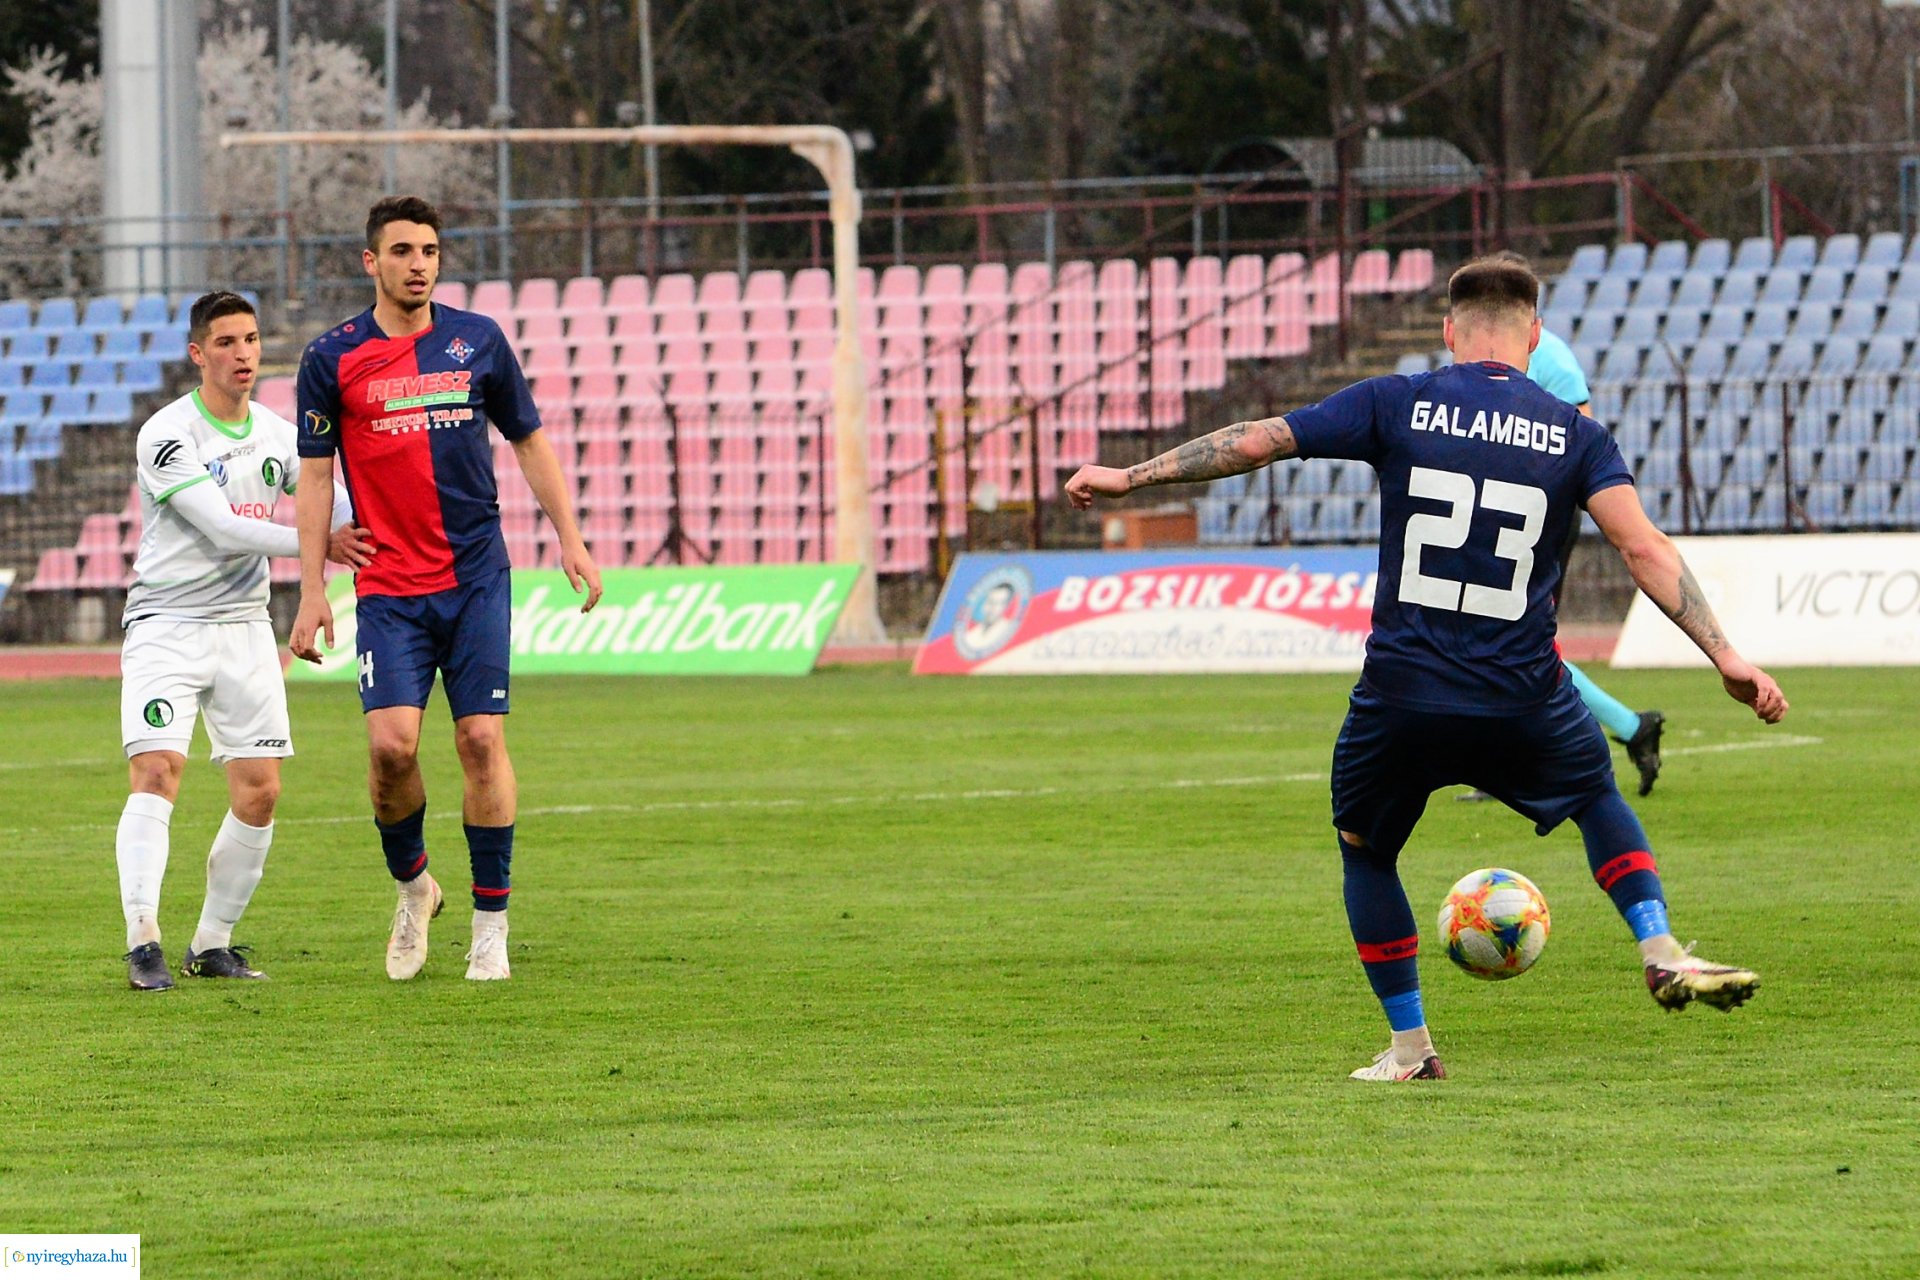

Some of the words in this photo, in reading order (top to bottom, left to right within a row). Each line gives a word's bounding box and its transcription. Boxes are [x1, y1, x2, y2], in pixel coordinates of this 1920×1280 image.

[367, 371, 471, 402] REVESZ
[1411, 401, 1566, 455] GALAMBOS
[1398, 466, 1547, 621] 23
[1056, 574, 1233, 612] BOZSIK
[1237, 562, 1377, 610] JÓZSE
[1776, 569, 1920, 617] VICTO
[511, 579, 838, 655] kantilbank
